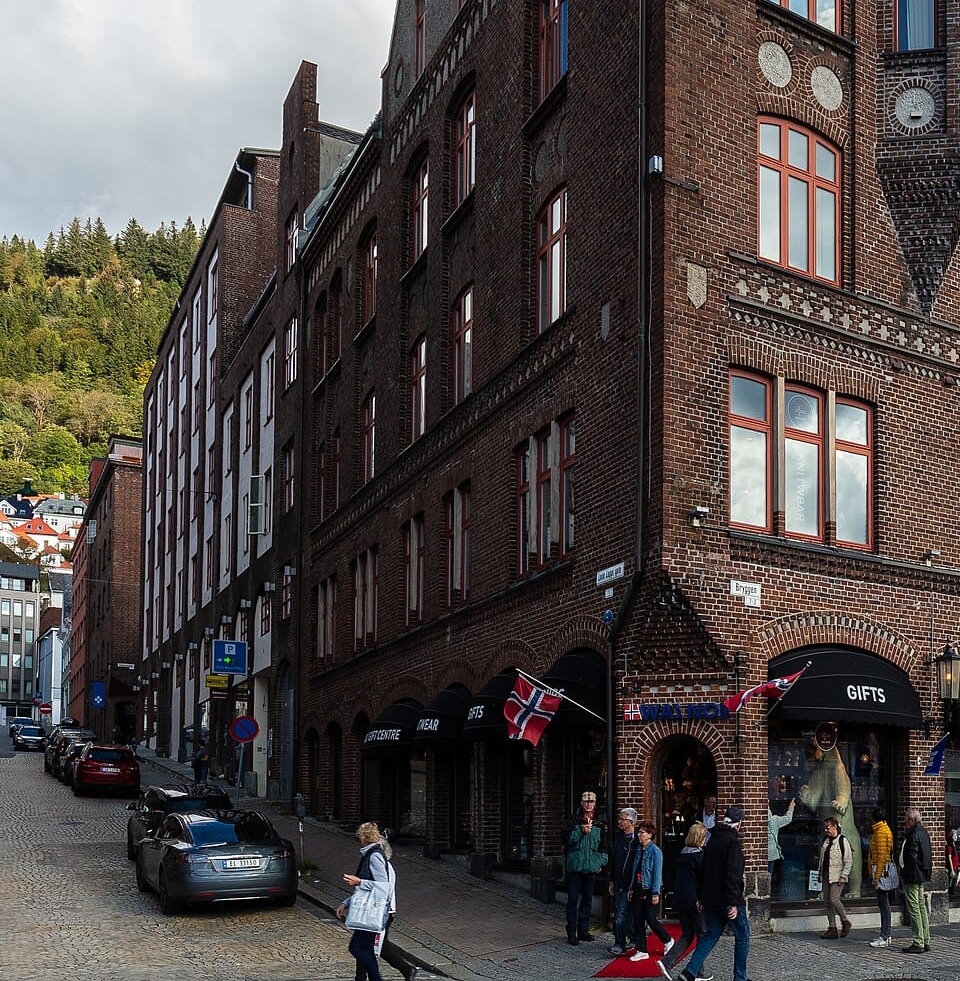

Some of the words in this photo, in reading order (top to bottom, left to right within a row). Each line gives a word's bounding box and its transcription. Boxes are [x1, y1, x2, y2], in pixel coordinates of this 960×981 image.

[735, 582, 757, 595] Bryggen
[846, 684, 887, 703] GIFTS
[377, 729, 402, 740] CENTRE
